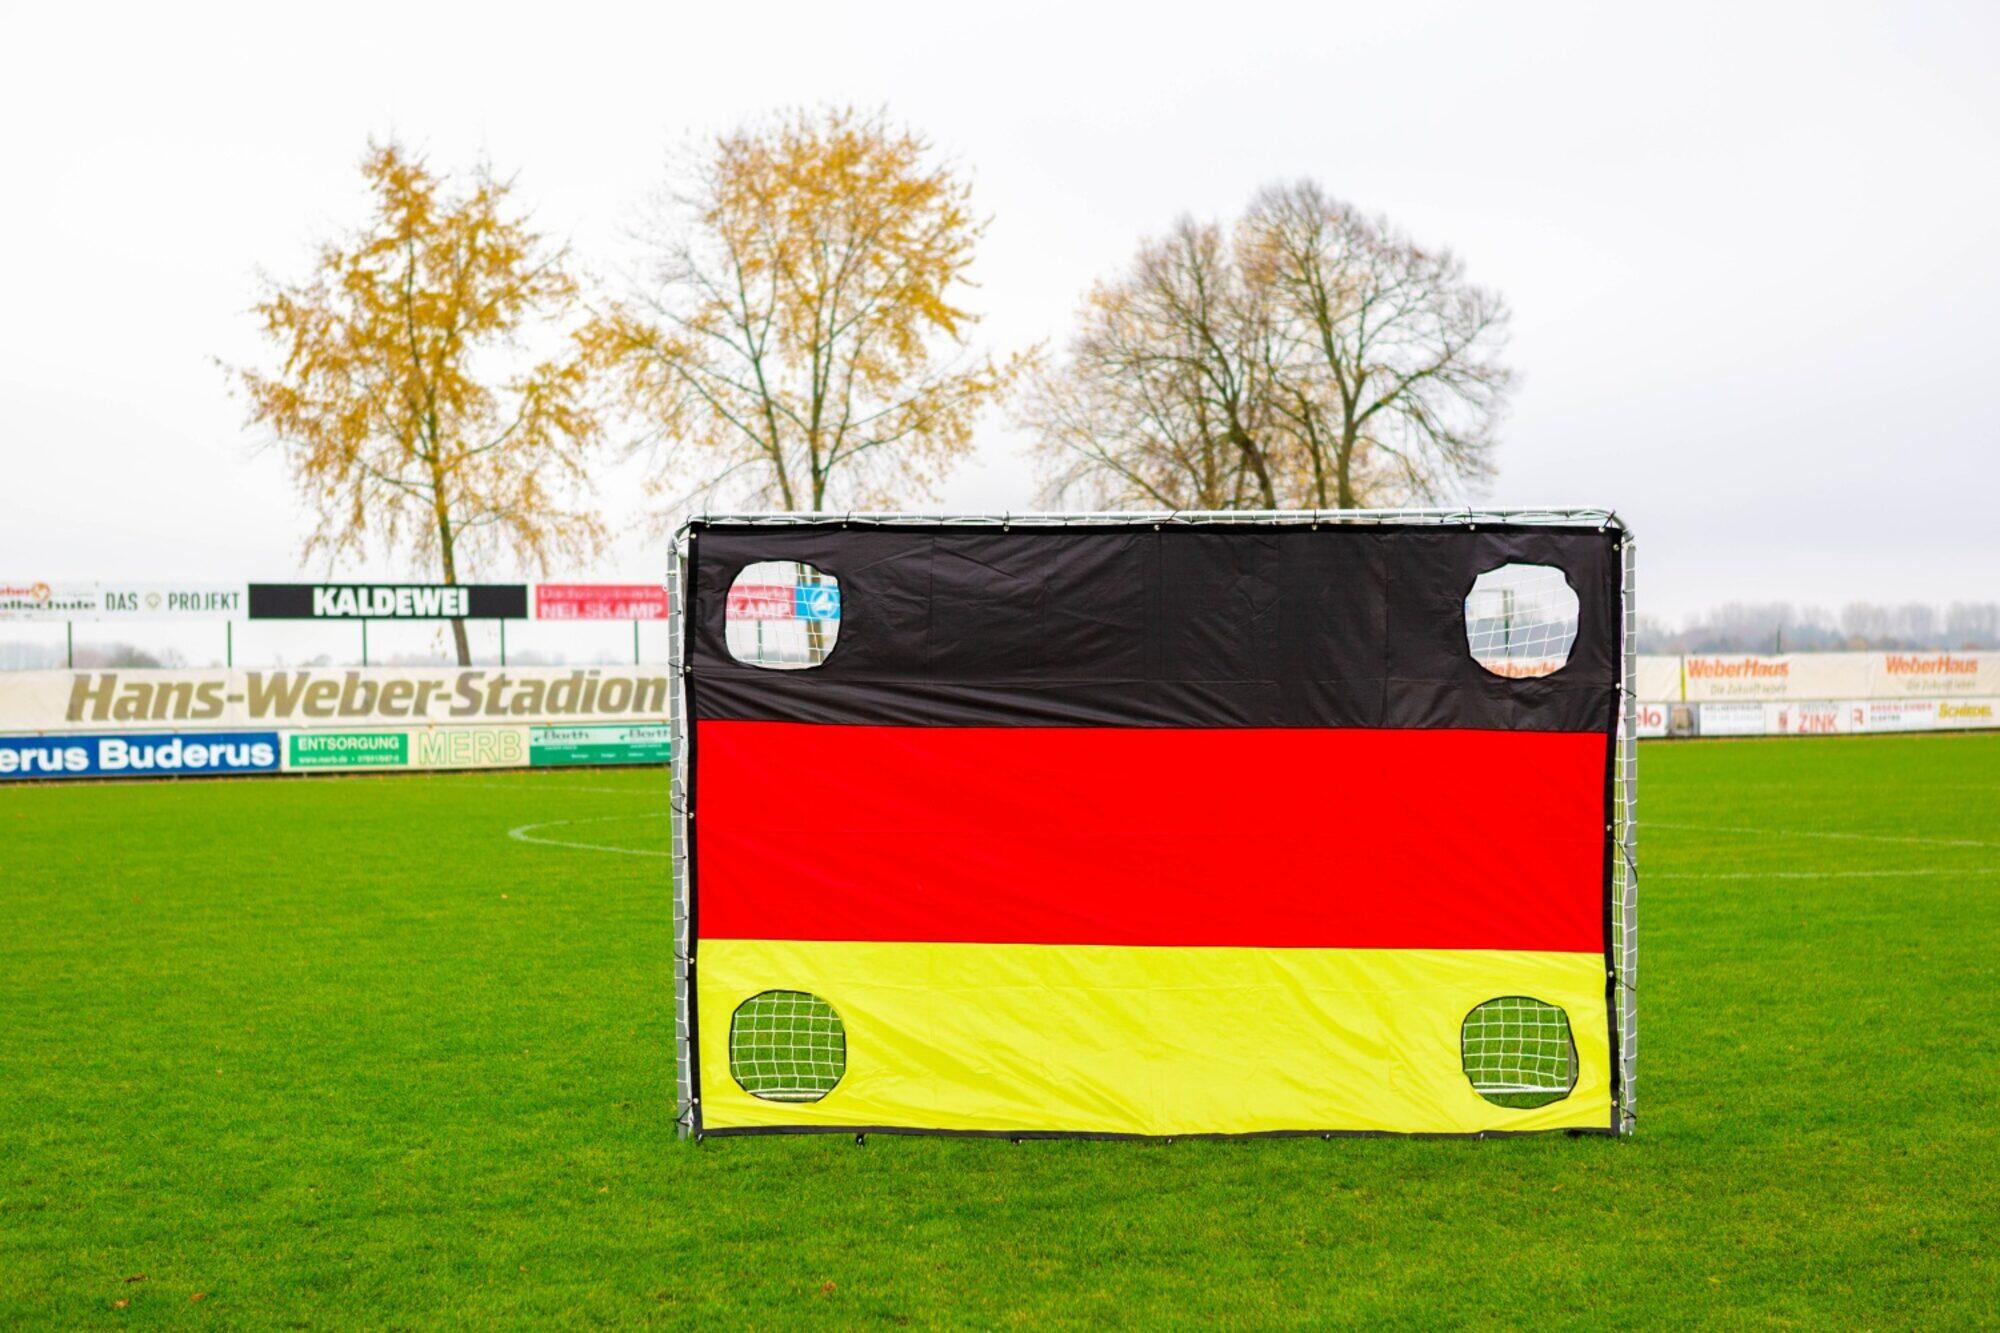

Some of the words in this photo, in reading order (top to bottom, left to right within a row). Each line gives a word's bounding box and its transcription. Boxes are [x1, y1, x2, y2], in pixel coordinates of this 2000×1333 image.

[106, 592, 138, 611] DAS
[168, 592, 241, 611] PROJEKT
[312, 587, 469, 616] KALDEWEI
[540, 602, 664, 619] NELSKAMP
[1688, 656, 1790, 679] WeberHaus
[1885, 654, 1978, 675] WeberHaus
[66, 670, 667, 722] Hans-Weber-Stadion
[1798, 712, 1840, 734] ZINK
[298, 736, 400, 751] ENTSORGUNG
[418, 732, 523, 767] MERB
[98, 739, 275, 771] Buderus
